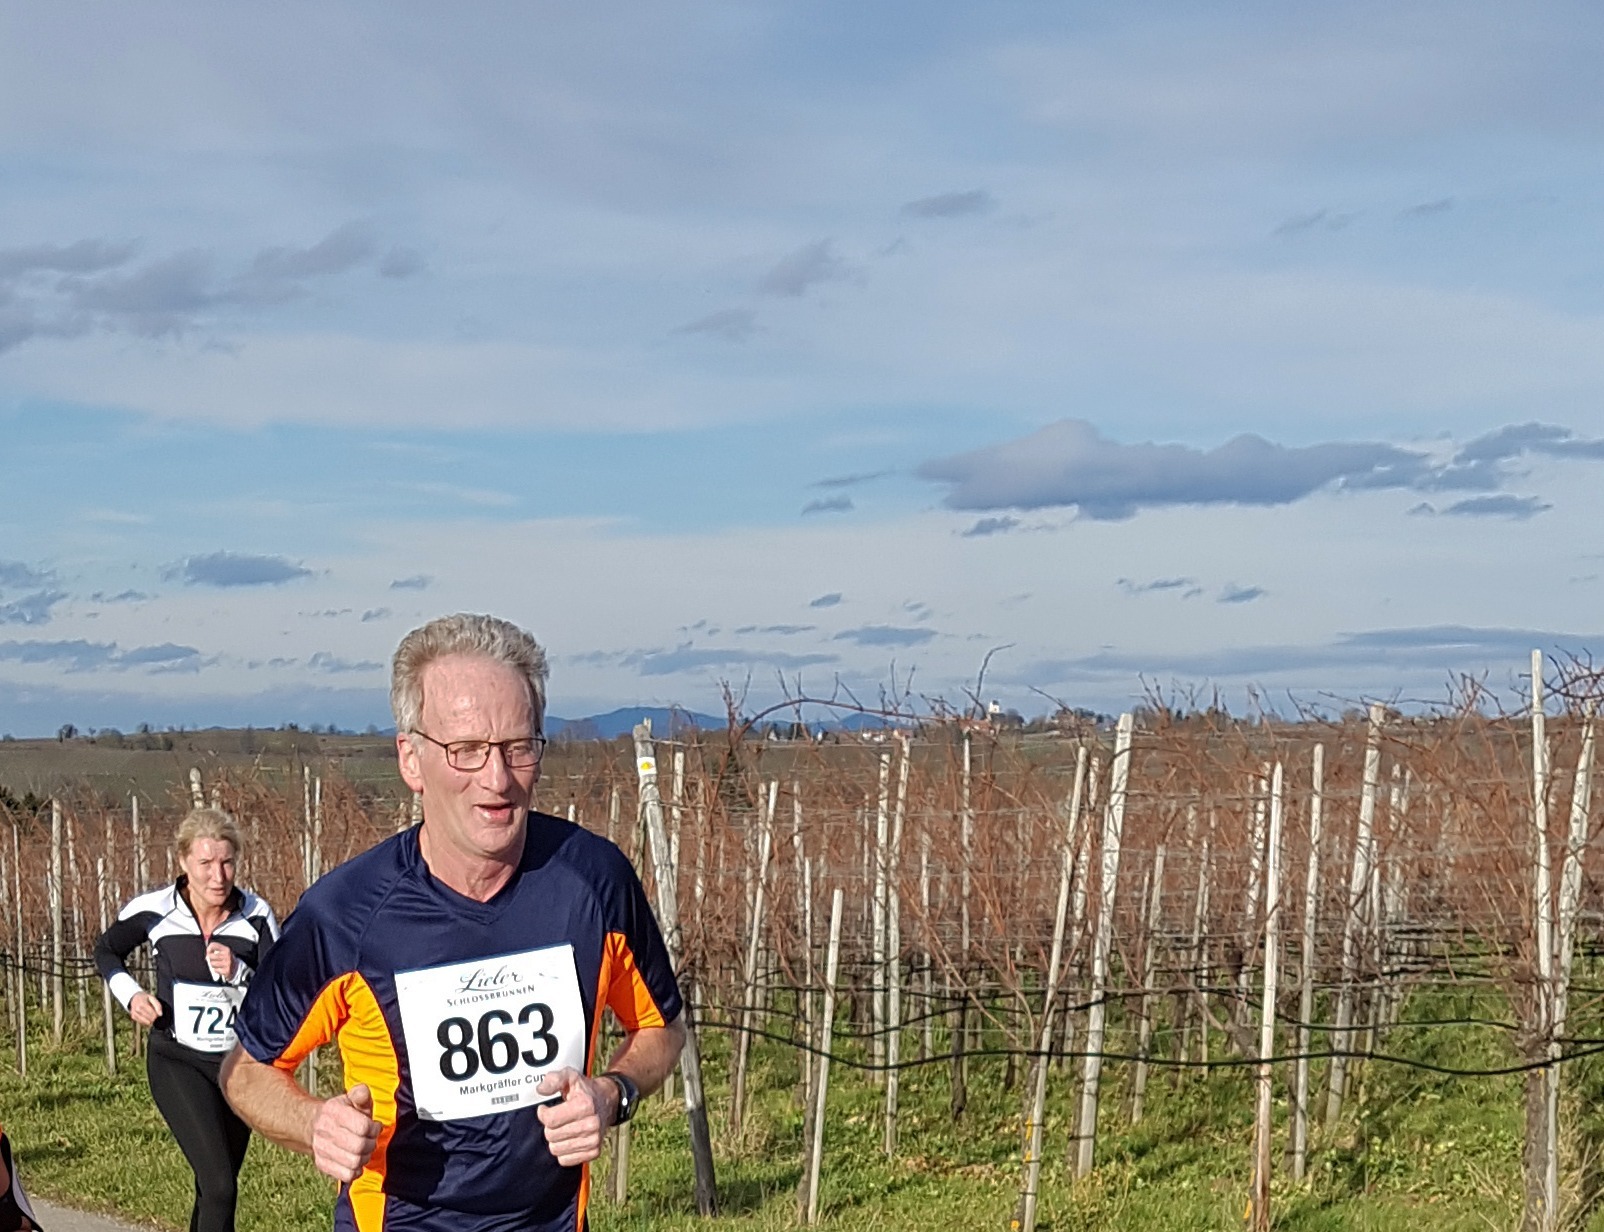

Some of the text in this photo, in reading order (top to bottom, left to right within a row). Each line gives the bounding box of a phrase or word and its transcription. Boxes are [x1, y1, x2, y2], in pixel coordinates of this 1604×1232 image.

[188, 1005, 238, 1035] 724
[437, 1002, 560, 1082] 863
[459, 1078, 521, 1095] Markgräfler
